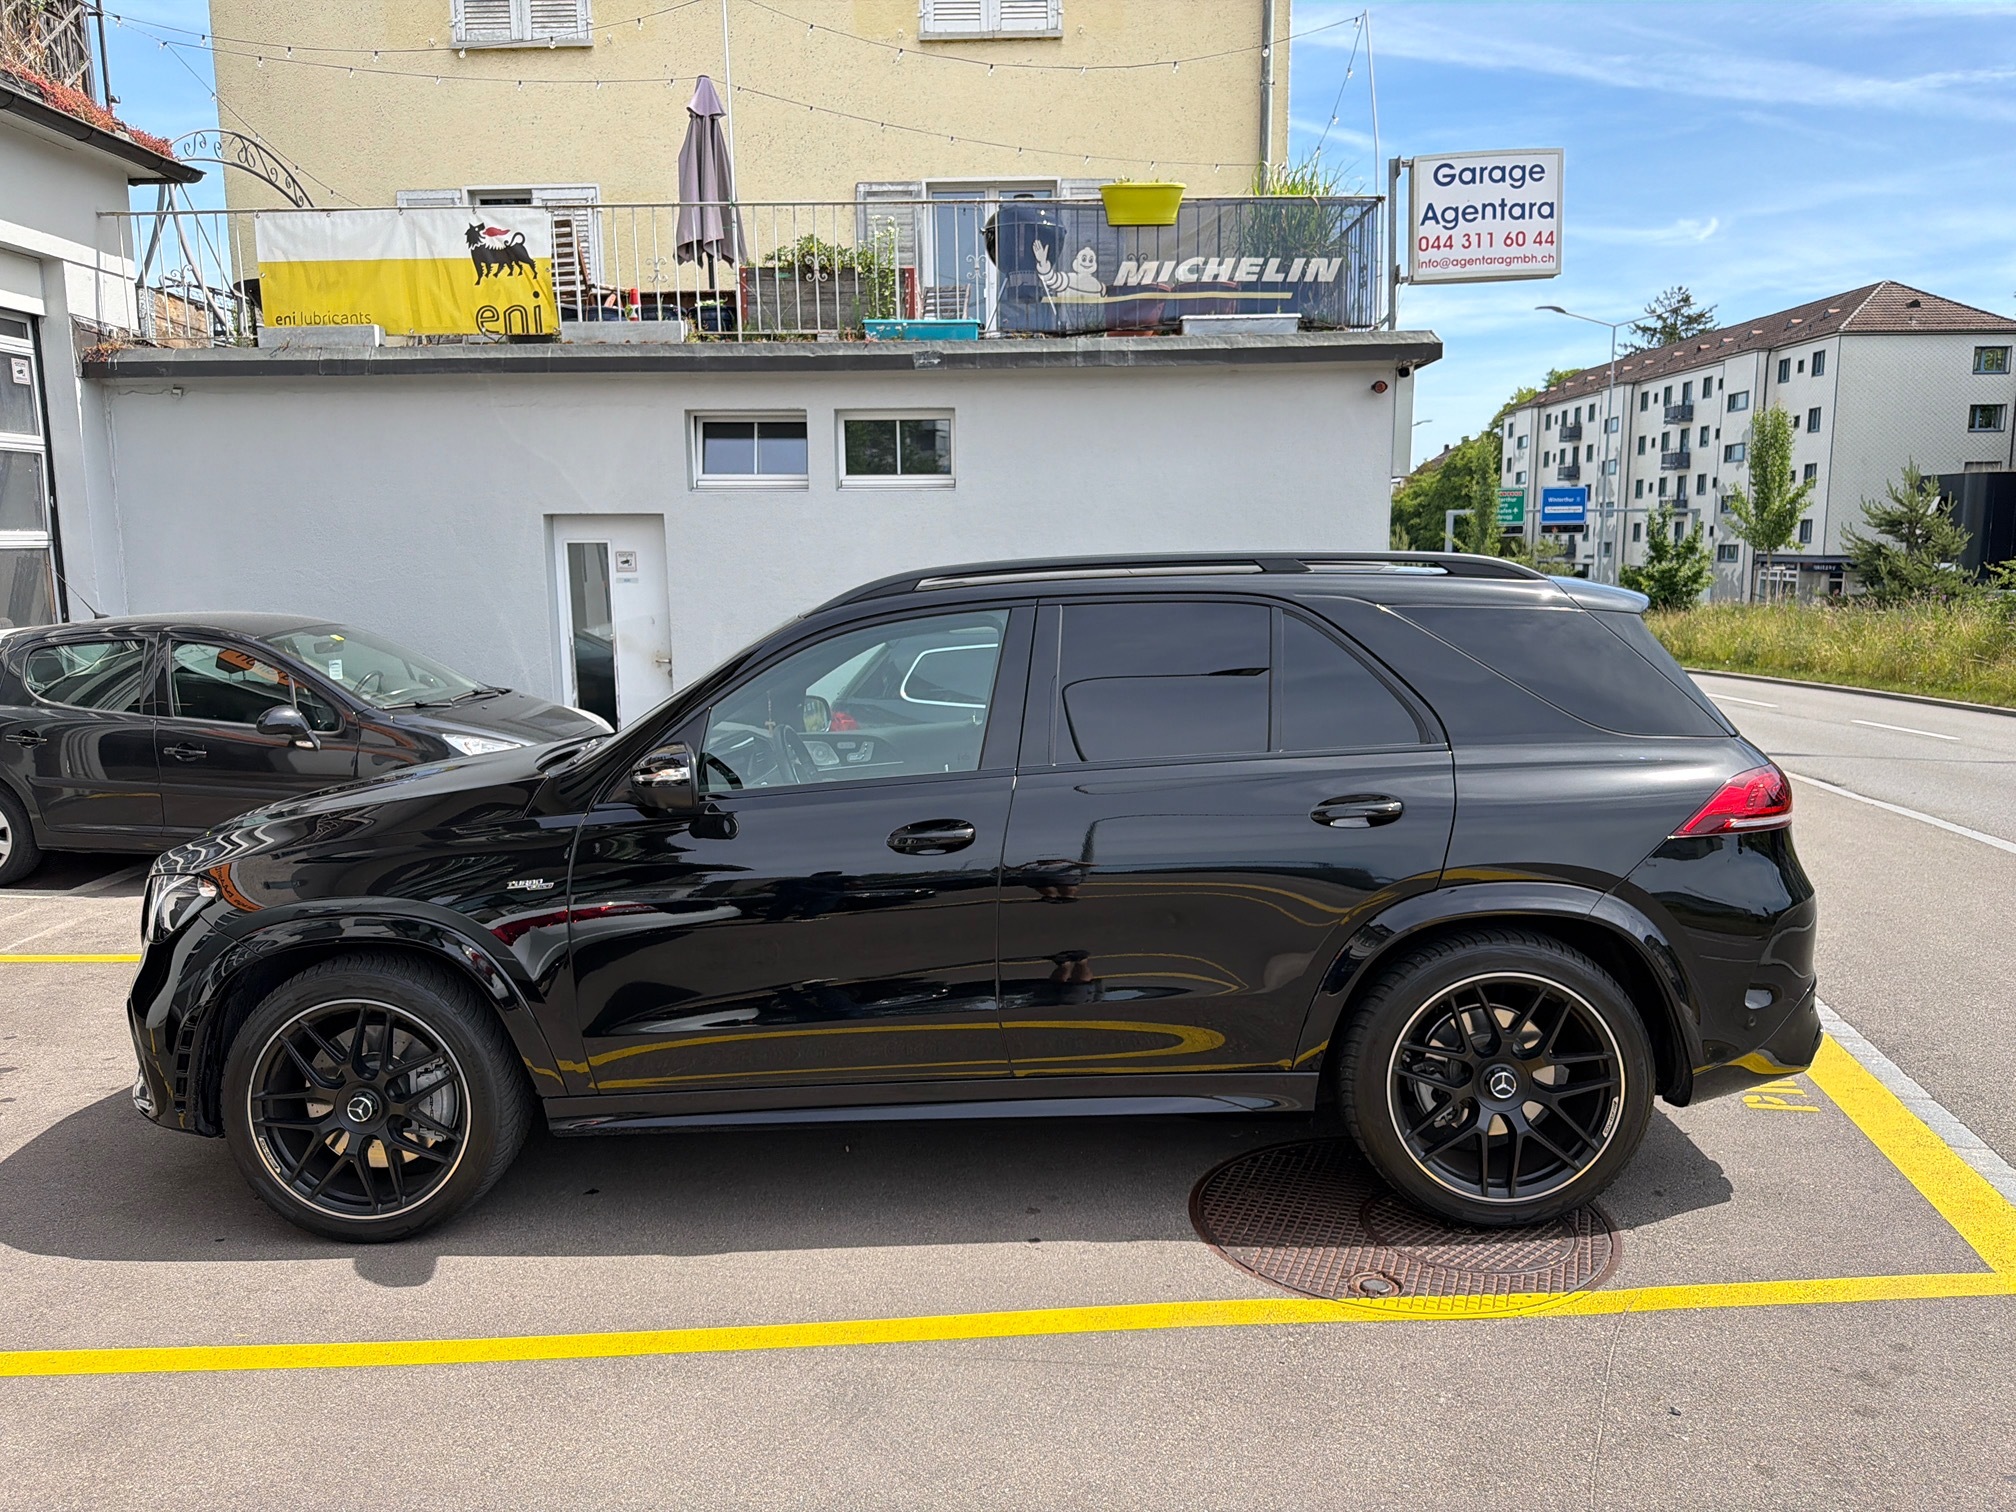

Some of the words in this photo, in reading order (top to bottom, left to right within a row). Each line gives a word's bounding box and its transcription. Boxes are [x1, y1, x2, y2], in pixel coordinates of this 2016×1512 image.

[1433, 163, 1545, 189] Garage
[1419, 197, 1555, 231] Agentara
[1418, 234, 1454, 252] 044
[1461, 232, 1494, 249] 311
[1503, 231, 1527, 248] 60
[1532, 230, 1555, 247] 44
[1113, 257, 1343, 286] MICHELIN
[1418, 253, 1555, 269] info@agentaragmbh.ch
[275, 311, 296, 326] eni
[299, 310, 372, 326] lubricants
[475, 290, 543, 335] eni
